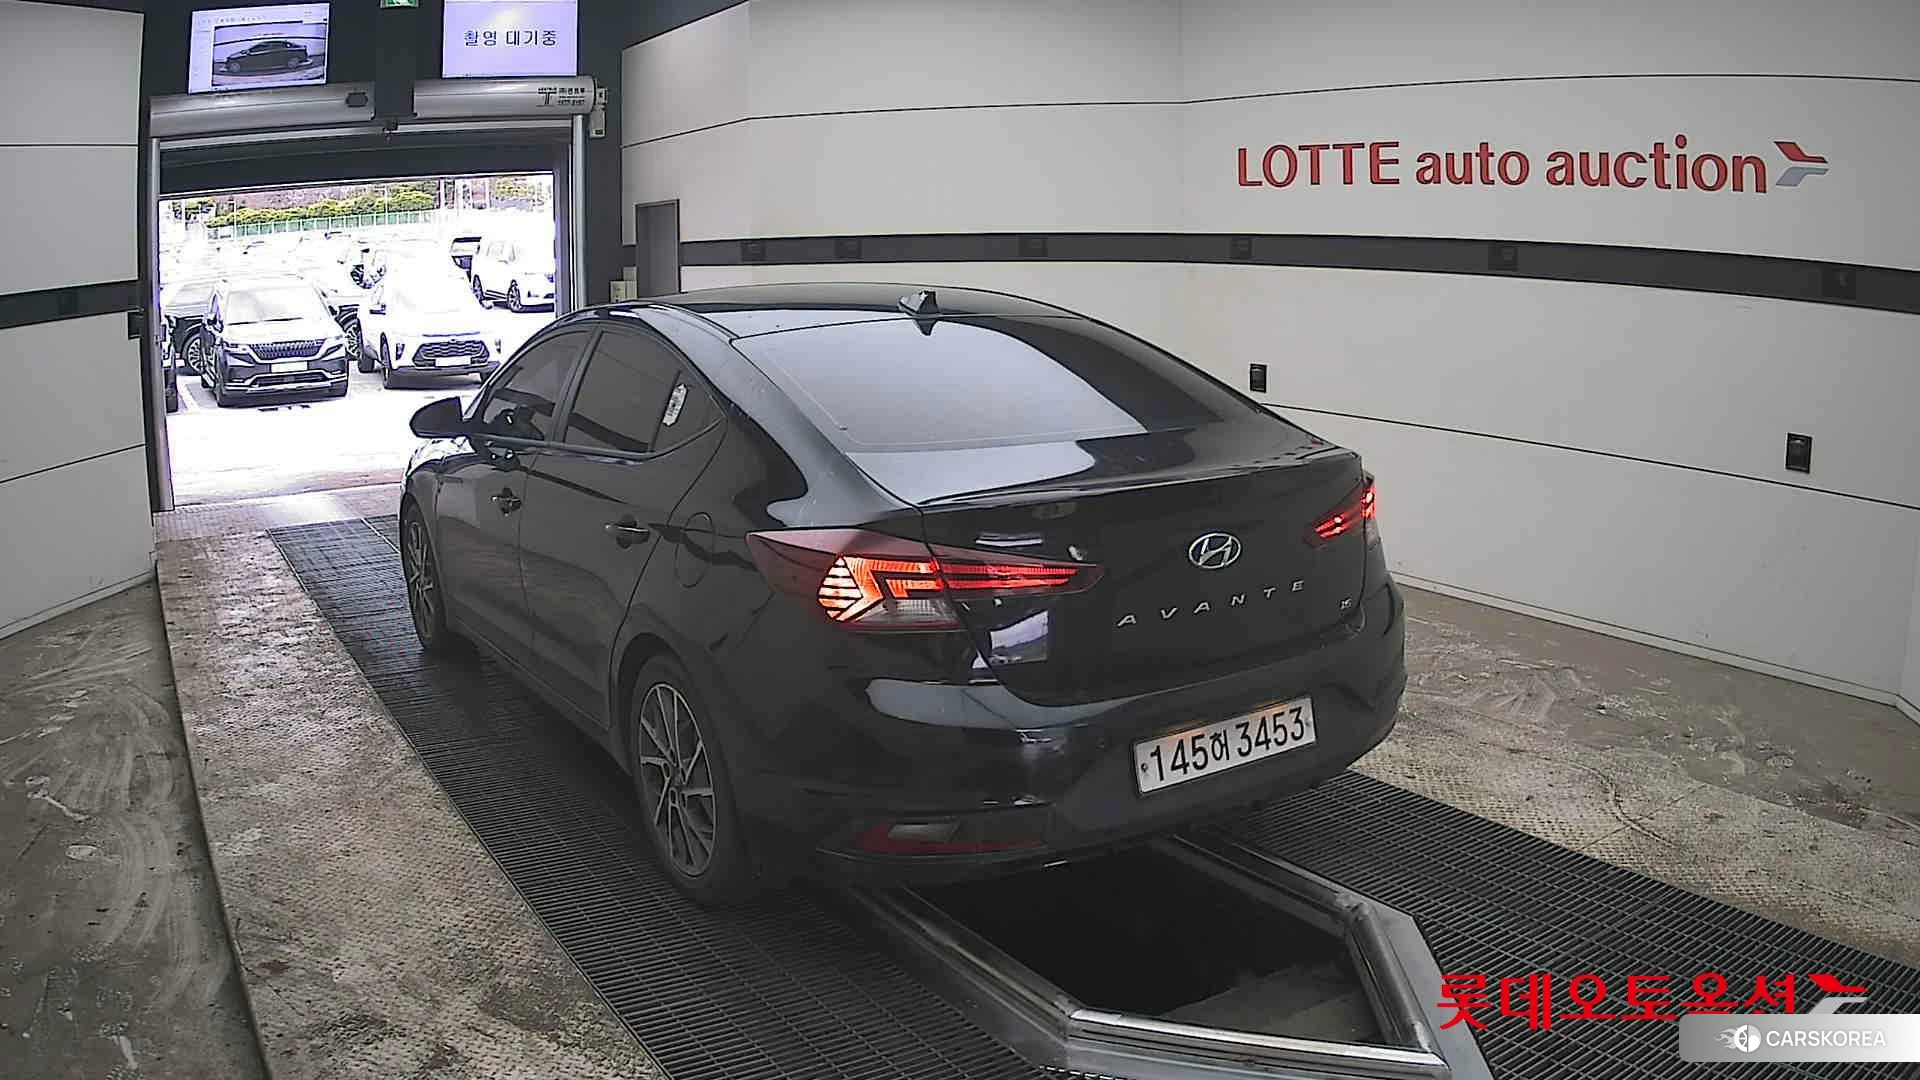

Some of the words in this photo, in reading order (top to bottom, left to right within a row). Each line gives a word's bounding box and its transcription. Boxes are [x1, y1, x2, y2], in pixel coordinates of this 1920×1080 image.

[464, 30, 497, 47] 촬영
[505, 30, 557, 47] 대기중
[1238, 141, 1400, 187] LOTTE
[1415, 141, 1531, 186] auto
[1545, 133, 1768, 194] auction
[1118, 580, 1304, 628] AVANTE
[1150, 729, 1230, 782] 145허
[1235, 707, 1305, 758] 3453
